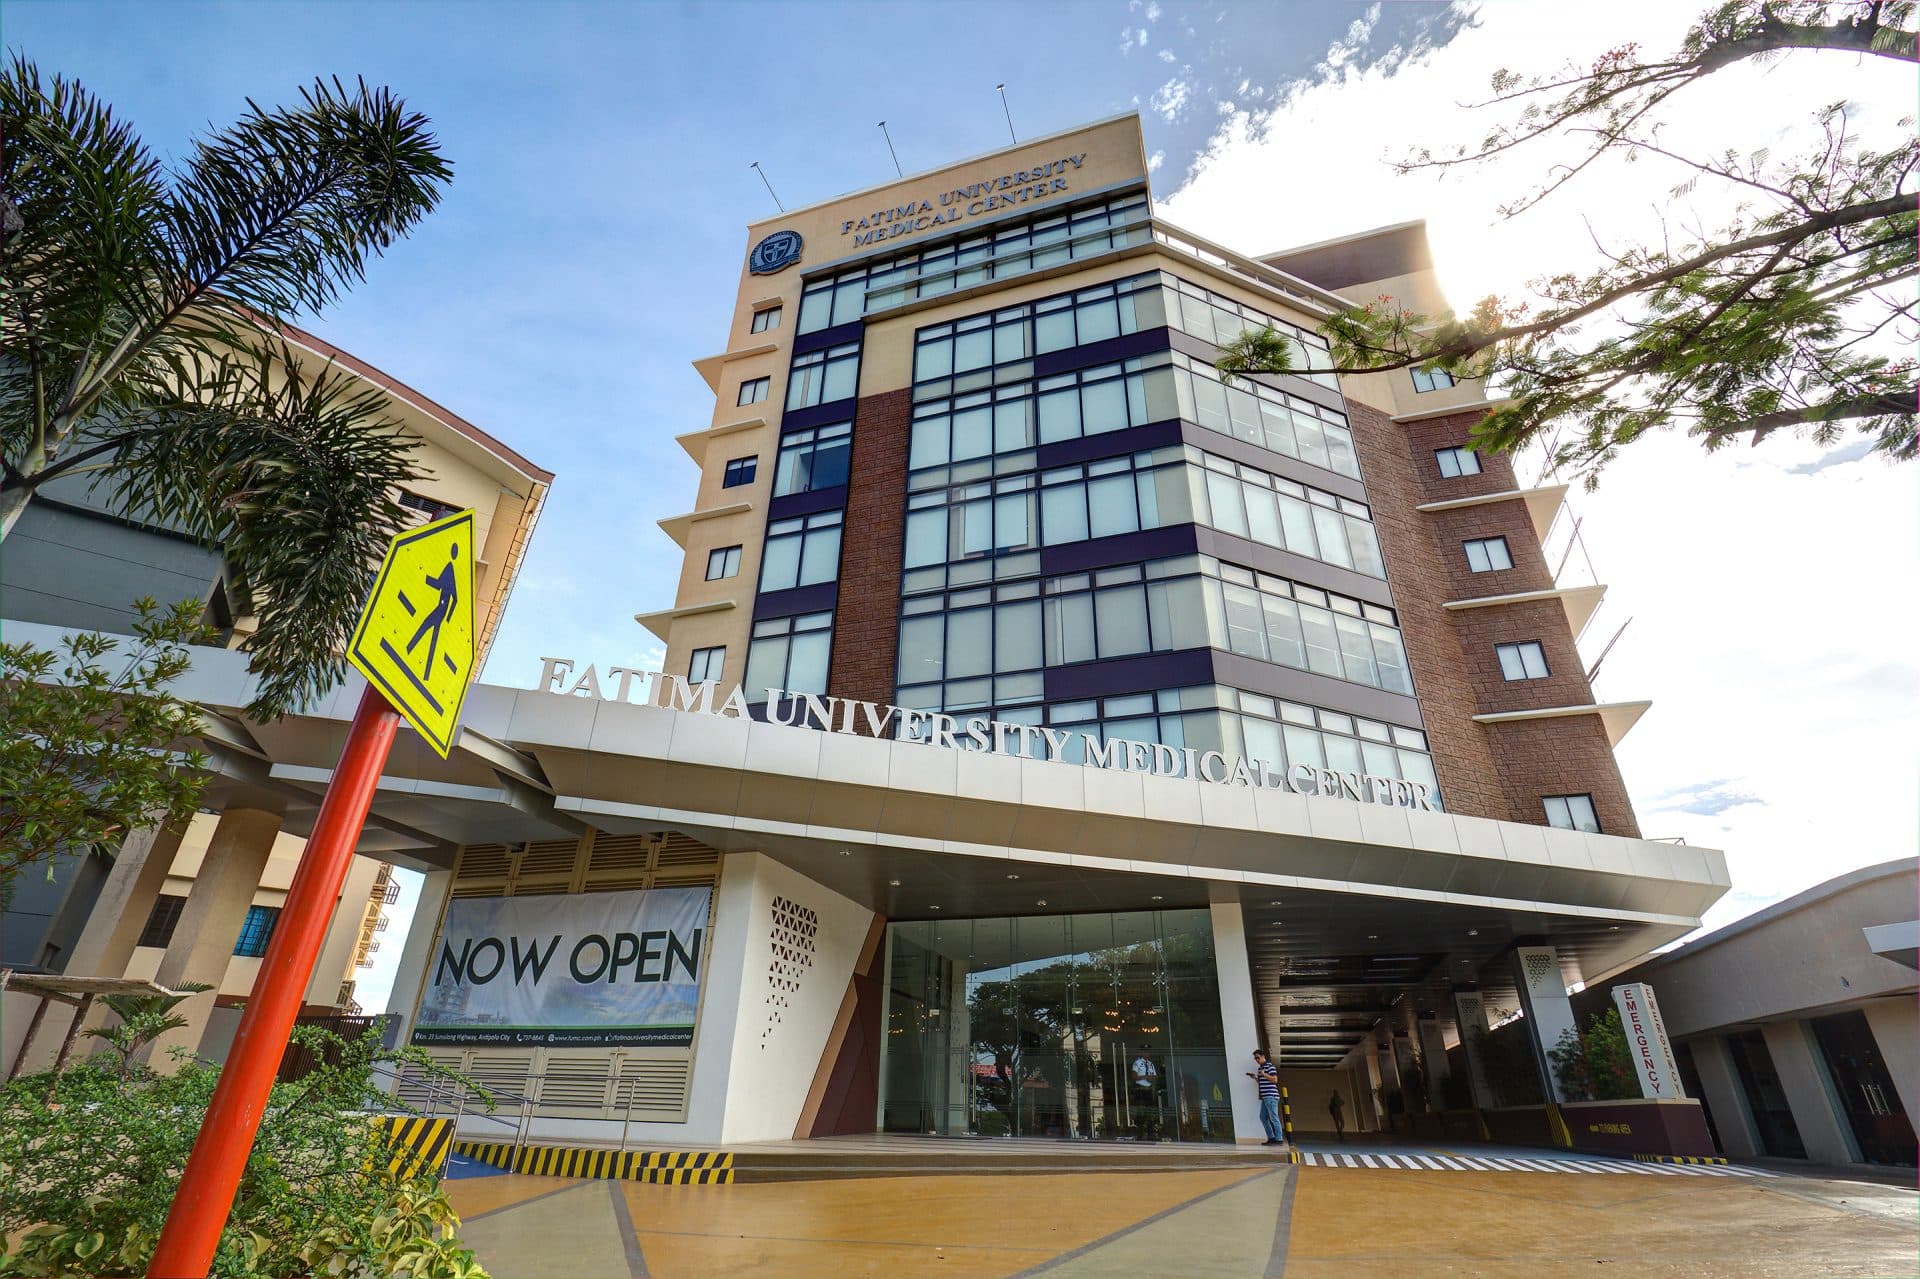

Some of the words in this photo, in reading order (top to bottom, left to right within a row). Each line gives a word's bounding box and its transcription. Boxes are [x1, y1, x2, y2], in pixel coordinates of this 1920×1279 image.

[841, 199, 933, 236] FATIMA
[940, 153, 1088, 206] UNIVERSITY
[853, 207, 963, 248] MEDICAL
[967, 177, 1068, 216] CENTER
[539, 656, 754, 721] FATIMA
[764, 687, 1073, 763] UNIVERSITY
[1081, 733, 1284, 793] MEDICAL
[1286, 763, 1435, 812] CENTER
[434, 935, 562, 987] NOW
[569, 928, 702, 985] OPEN
[500, 1033, 511, 1043] City
[1623, 989, 1660, 1094] EMERGENCY
